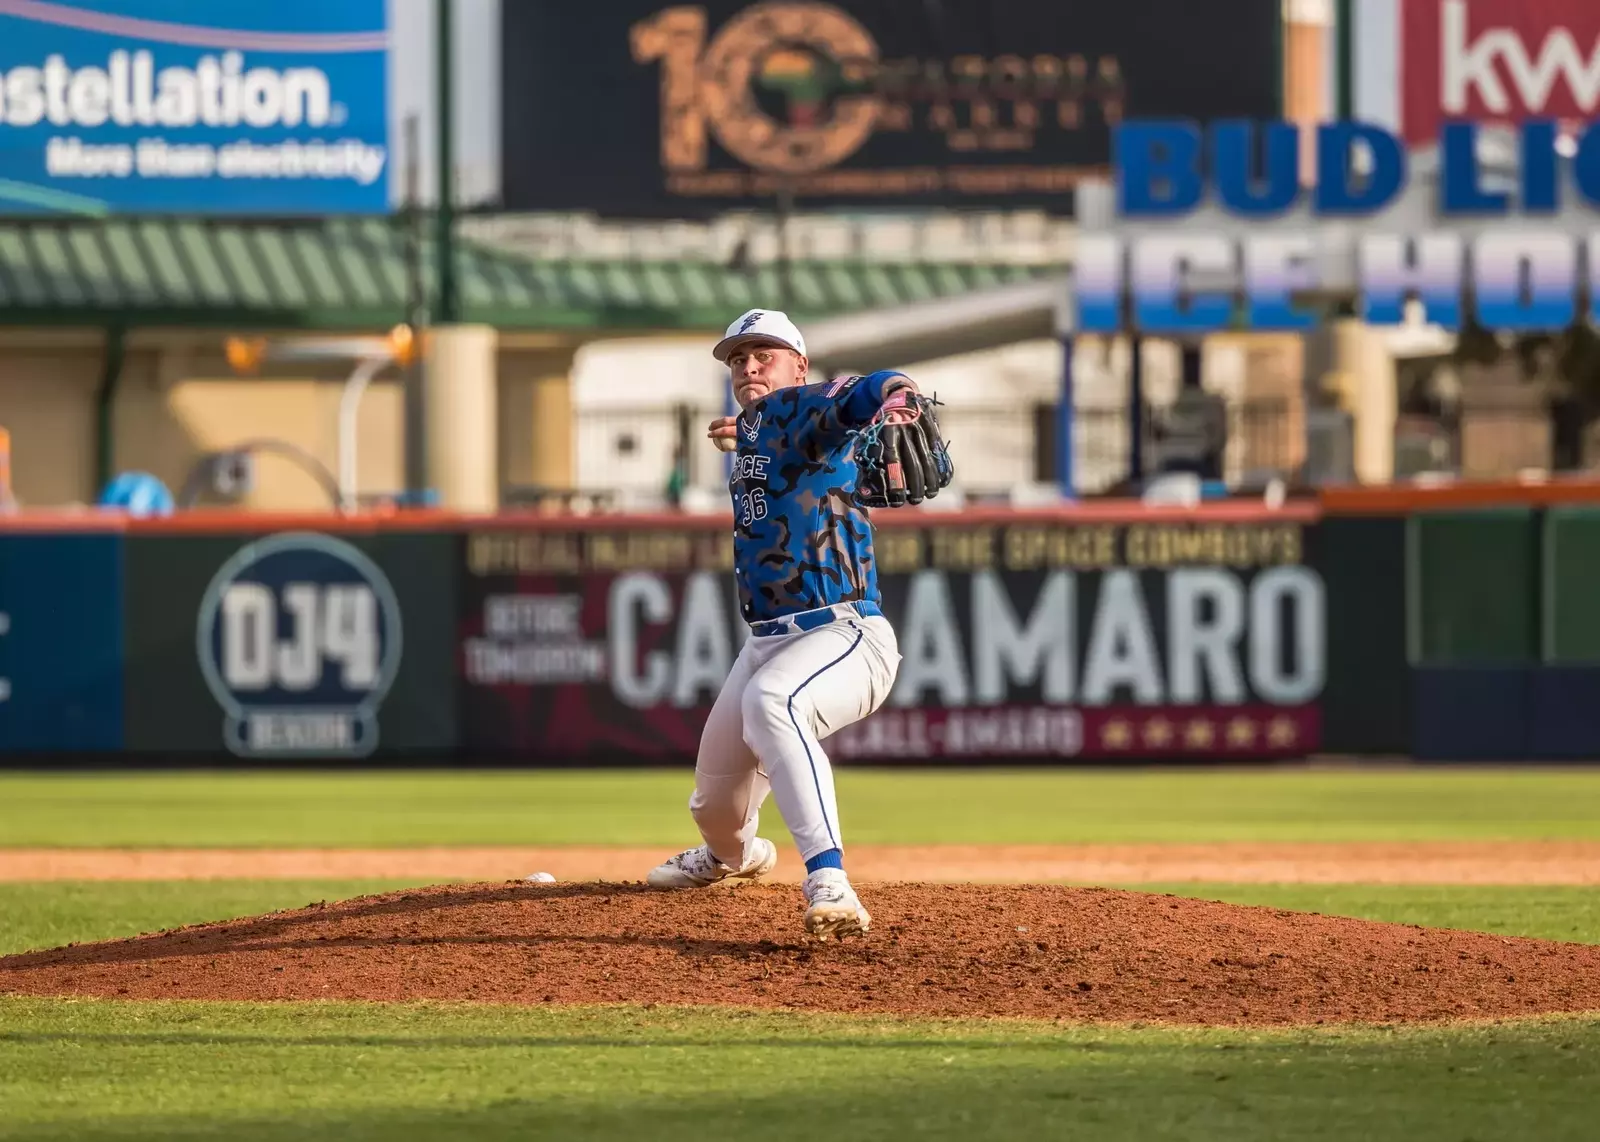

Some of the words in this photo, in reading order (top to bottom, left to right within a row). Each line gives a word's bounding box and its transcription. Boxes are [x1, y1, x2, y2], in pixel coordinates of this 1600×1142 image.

[0, 49, 330, 128] stellation
[46, 137, 133, 178] More
[136, 138, 214, 178] than
[217, 139, 386, 185] electricity
[1114, 118, 1406, 218] BUD
[1439, 118, 1600, 218] LI
[1076, 232, 1318, 331] ICE
[1361, 232, 1600, 331] HO
[741, 487, 768, 527] 36
[876, 529, 922, 572] OR
[930, 527, 992, 570] THE
[1004, 526, 1114, 569] SPACE
[1126, 524, 1303, 567] COWBOYS
[221, 581, 379, 690] DJ4
[607, 570, 740, 710] CA
[893, 564, 1327, 706] AMARO
